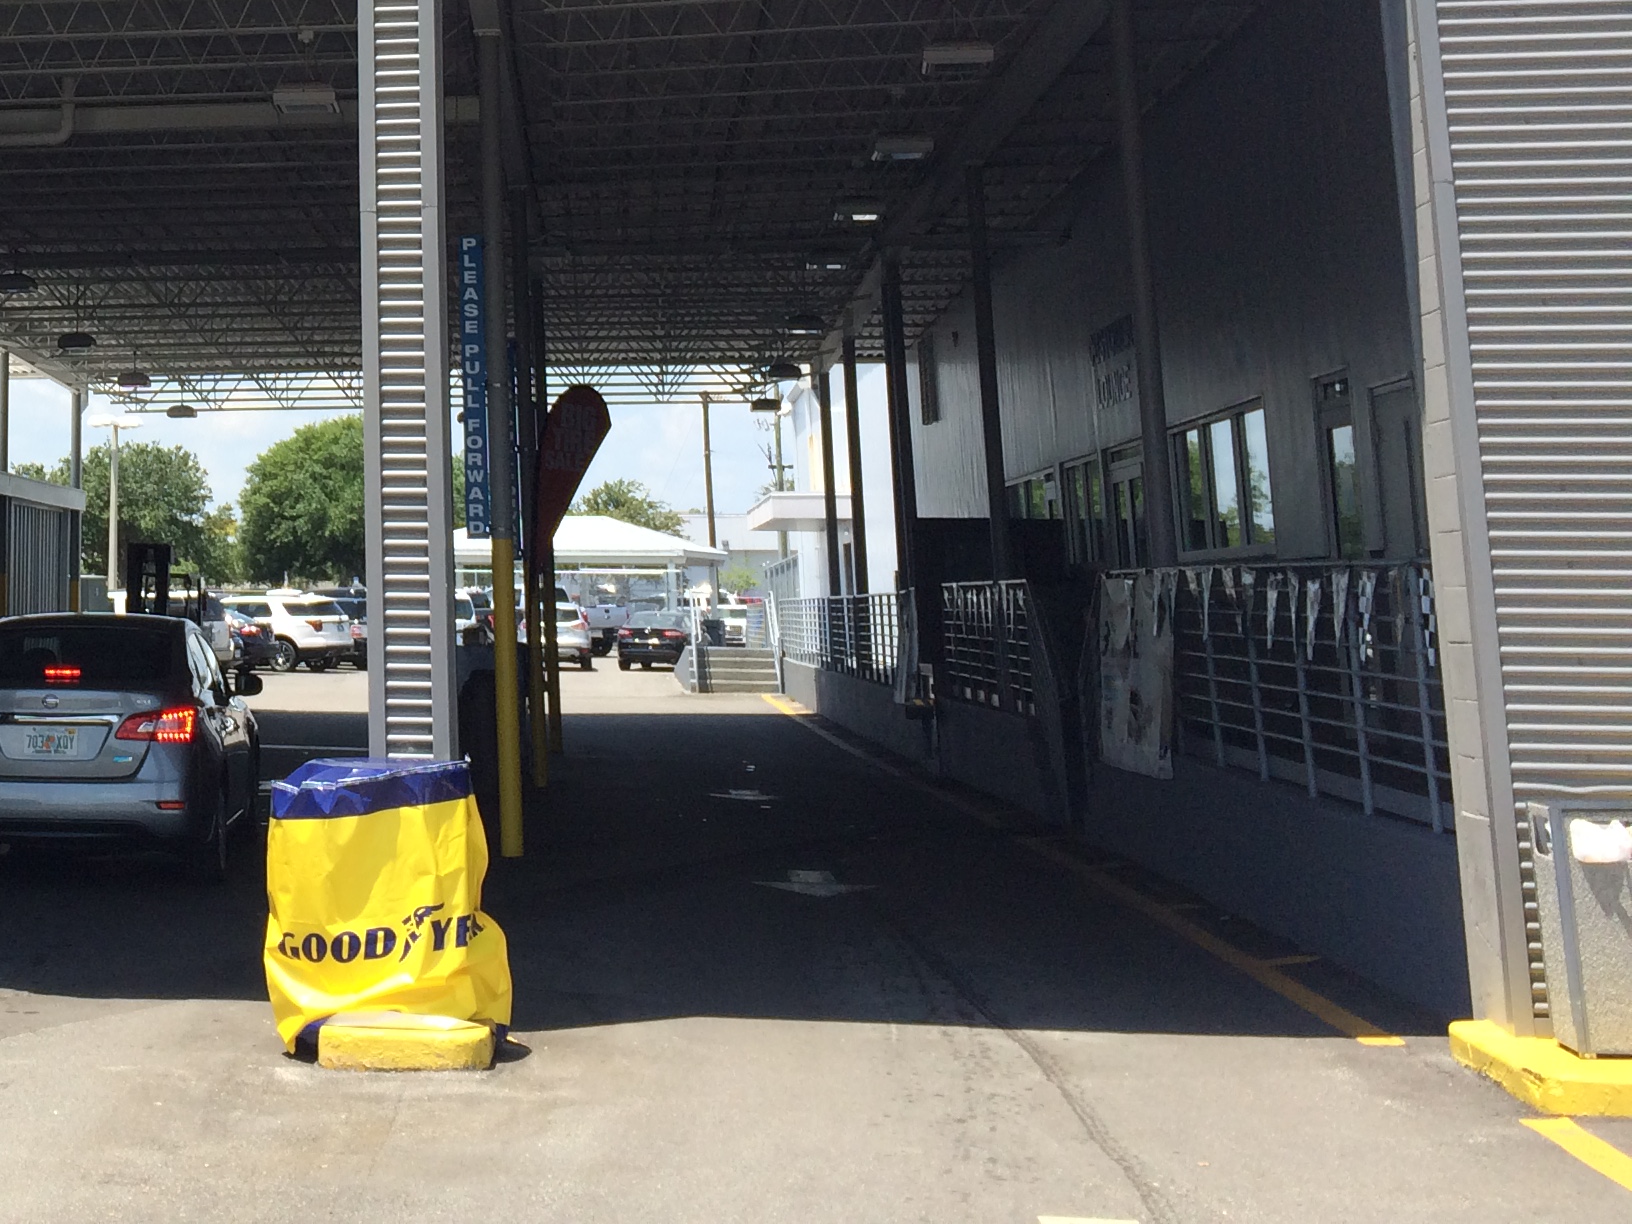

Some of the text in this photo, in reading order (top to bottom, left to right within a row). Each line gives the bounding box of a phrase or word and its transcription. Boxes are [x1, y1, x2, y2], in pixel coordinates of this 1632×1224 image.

[461, 237, 485, 534] PLEASE PULL FORWARD
[1097, 364, 1133, 410] LOUNGE
[560, 402, 598, 430] BIG
[545, 449, 584, 473] SALE
[277, 913, 485, 964] GOODYEA
